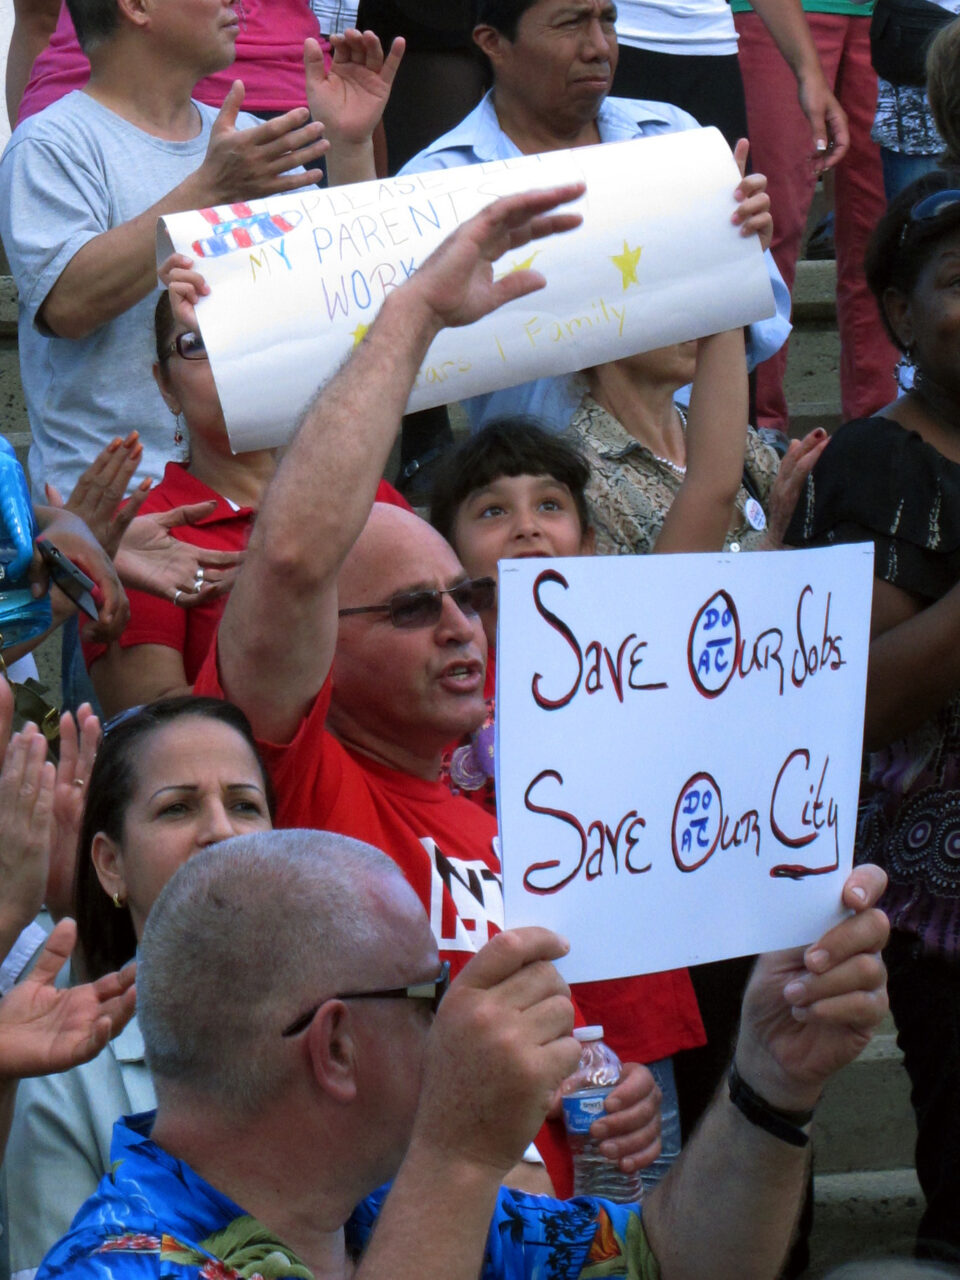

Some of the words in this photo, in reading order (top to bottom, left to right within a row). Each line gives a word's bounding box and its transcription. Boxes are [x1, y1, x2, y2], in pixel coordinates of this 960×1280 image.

[249, 238, 292, 282] MY
[523, 298, 626, 347] Family
[703, 608, 732, 630] DO
[697, 647, 728, 675] AC
[683, 790, 712, 814] DO
[769, 748, 839, 872] City
[681, 823, 709, 853] AC
